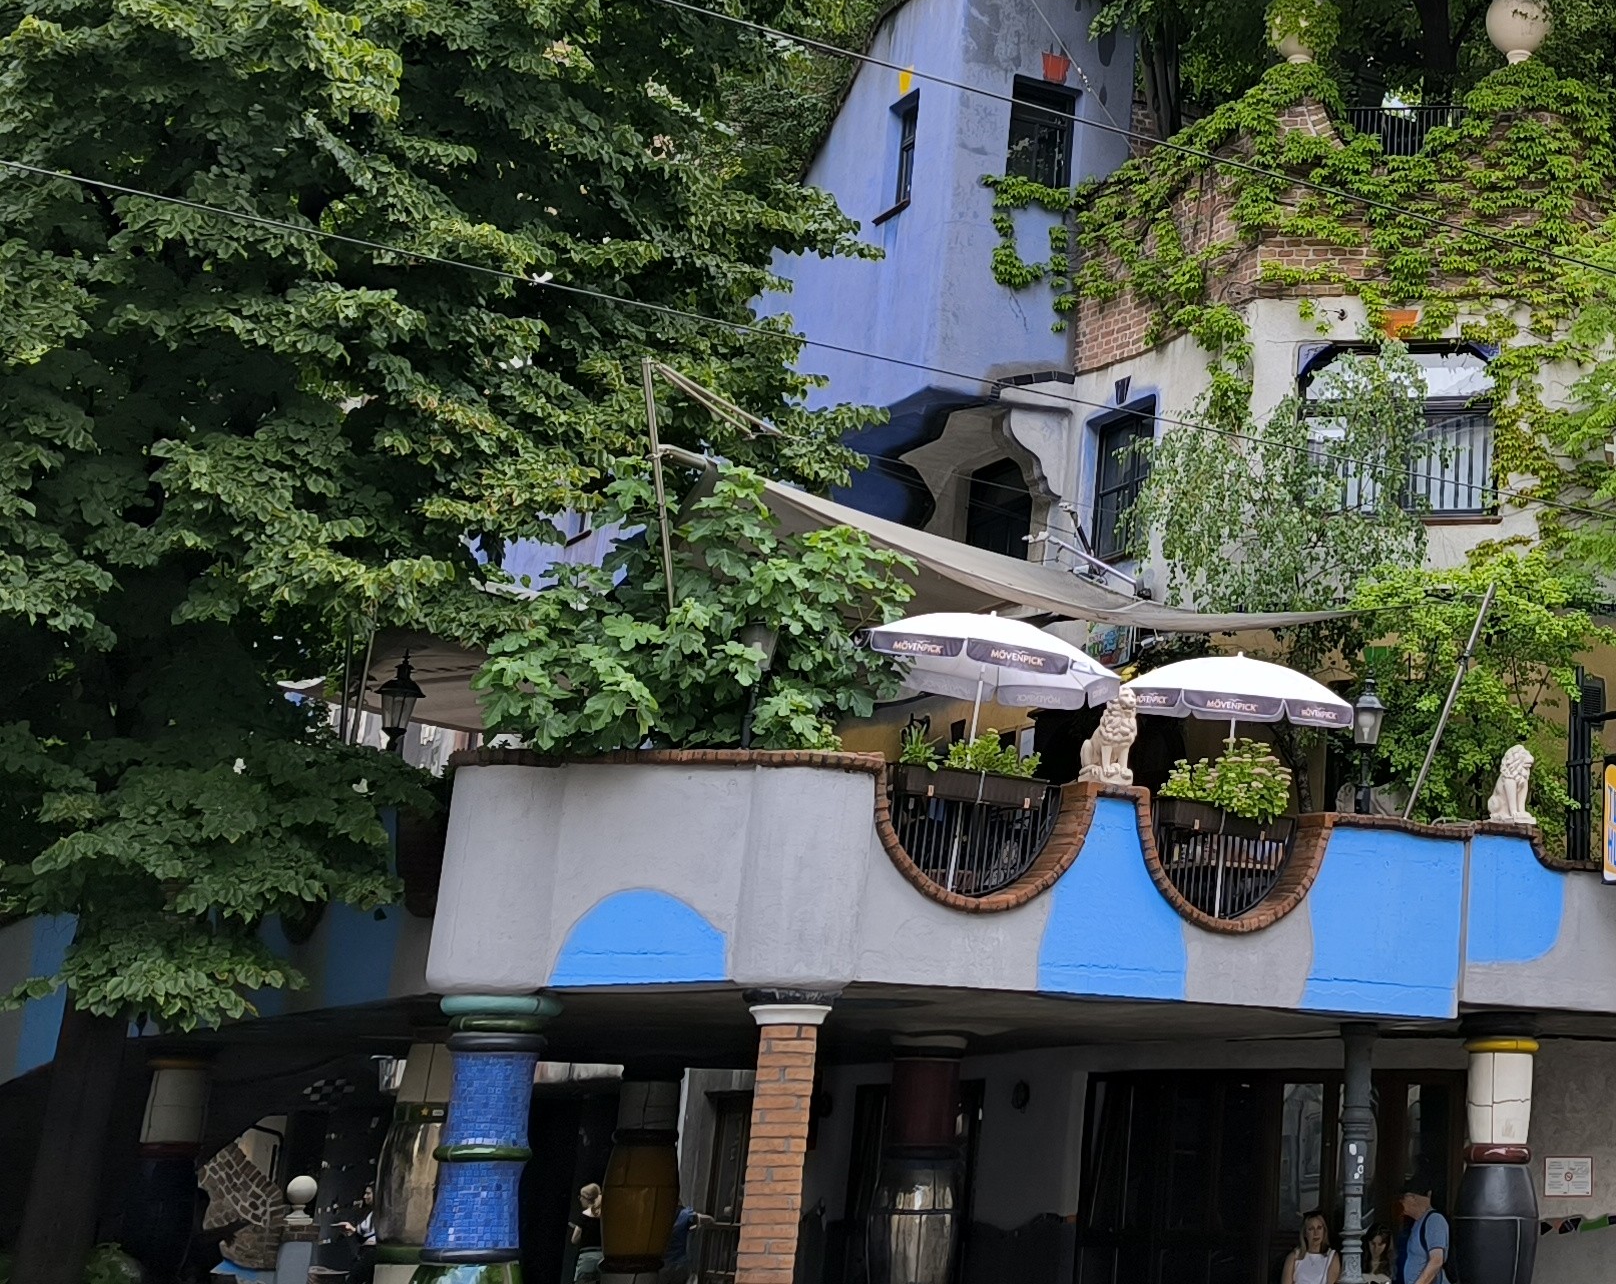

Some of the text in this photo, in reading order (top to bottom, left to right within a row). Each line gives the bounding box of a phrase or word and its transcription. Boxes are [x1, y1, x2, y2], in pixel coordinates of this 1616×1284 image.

[892, 640, 943, 654] MÖVENPICK
[990, 648, 1045, 667] MÖVENPICK
[1206, 699, 1258, 712] MÖVENPICK
[1301, 707, 1338, 720] MÖVENPICK
